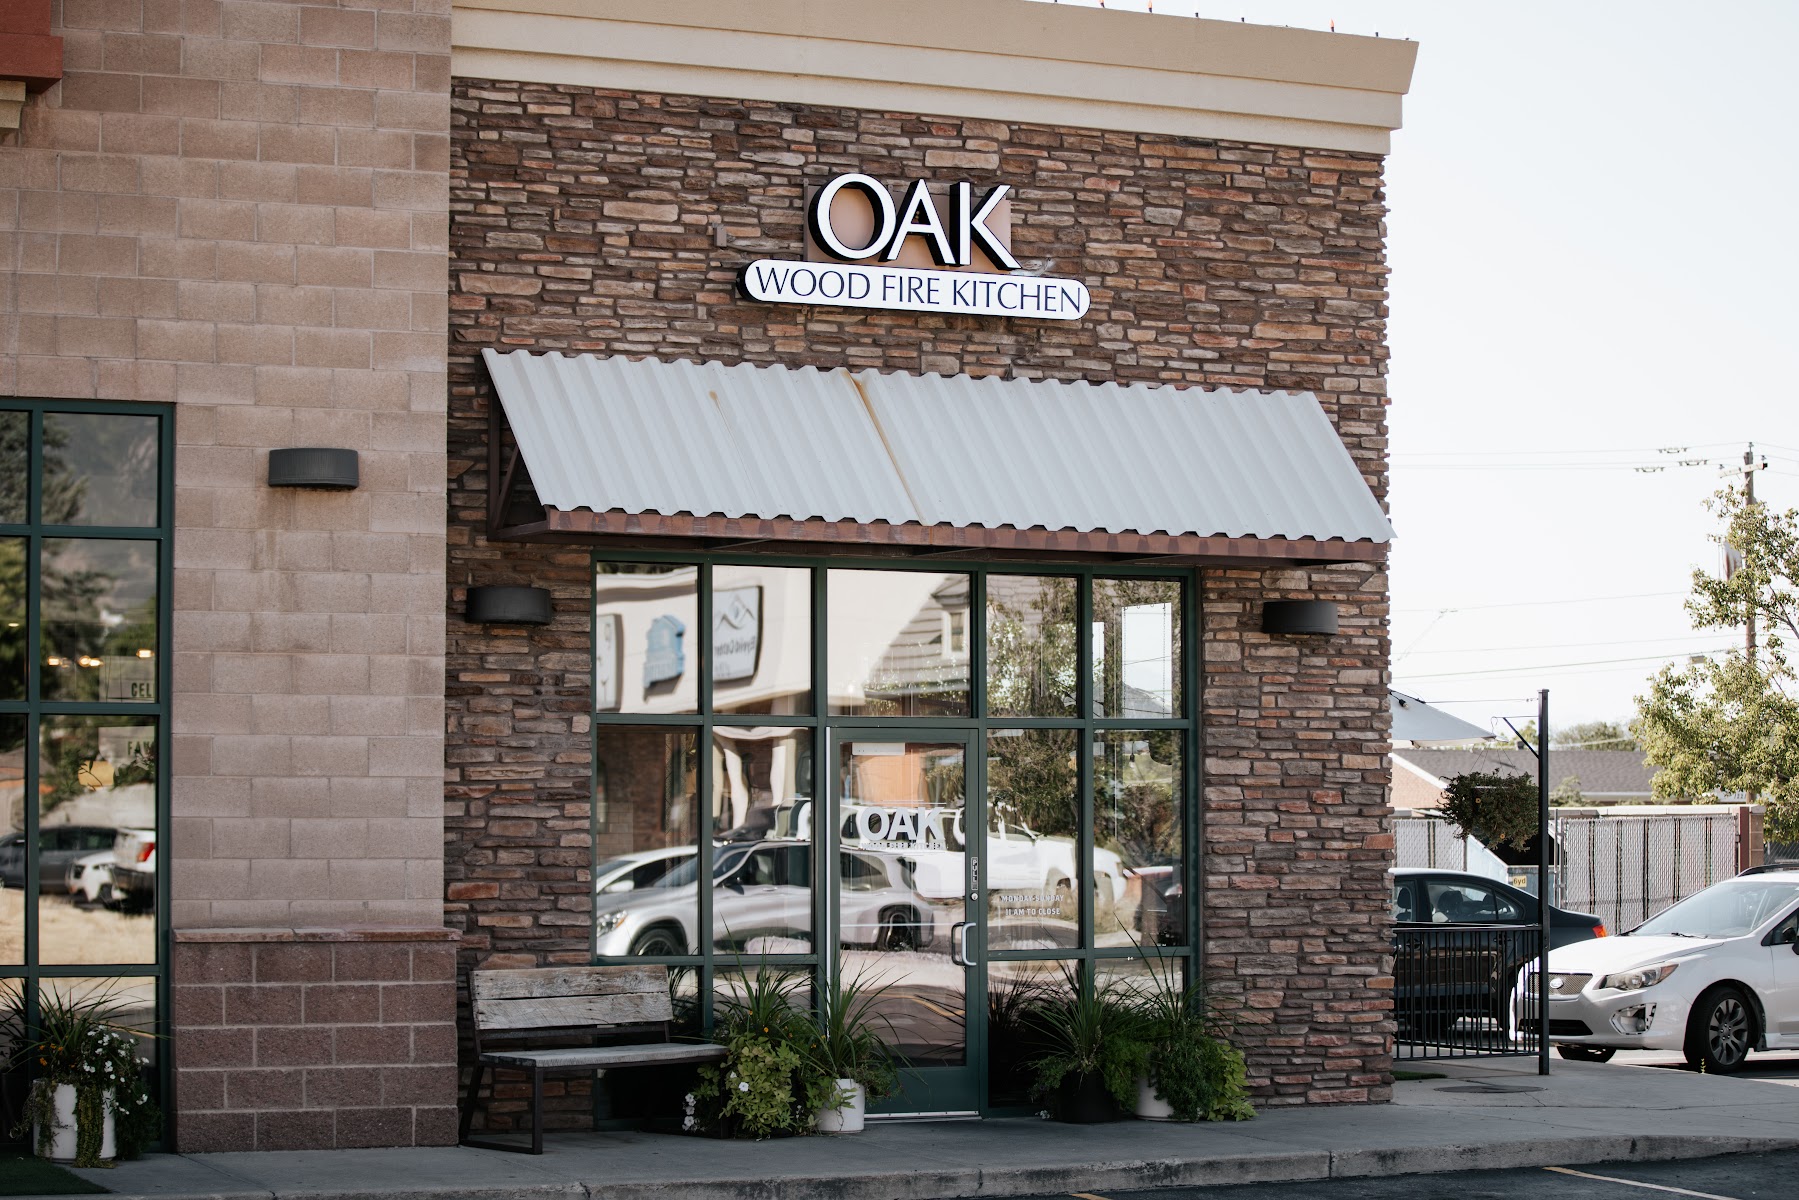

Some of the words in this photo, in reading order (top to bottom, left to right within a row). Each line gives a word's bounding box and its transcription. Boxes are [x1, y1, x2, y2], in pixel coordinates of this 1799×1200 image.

[812, 172, 1022, 270] OAK
[755, 266, 871, 300] WOOD
[882, 274, 941, 305] FIRE
[952, 279, 1082, 314] KITCHEN
[860, 806, 945, 841] OAK
[1513, 877, 1526, 886] 6yd
[1013, 908, 1025, 916] AM
[1038, 907, 1061, 915] CLOSE
